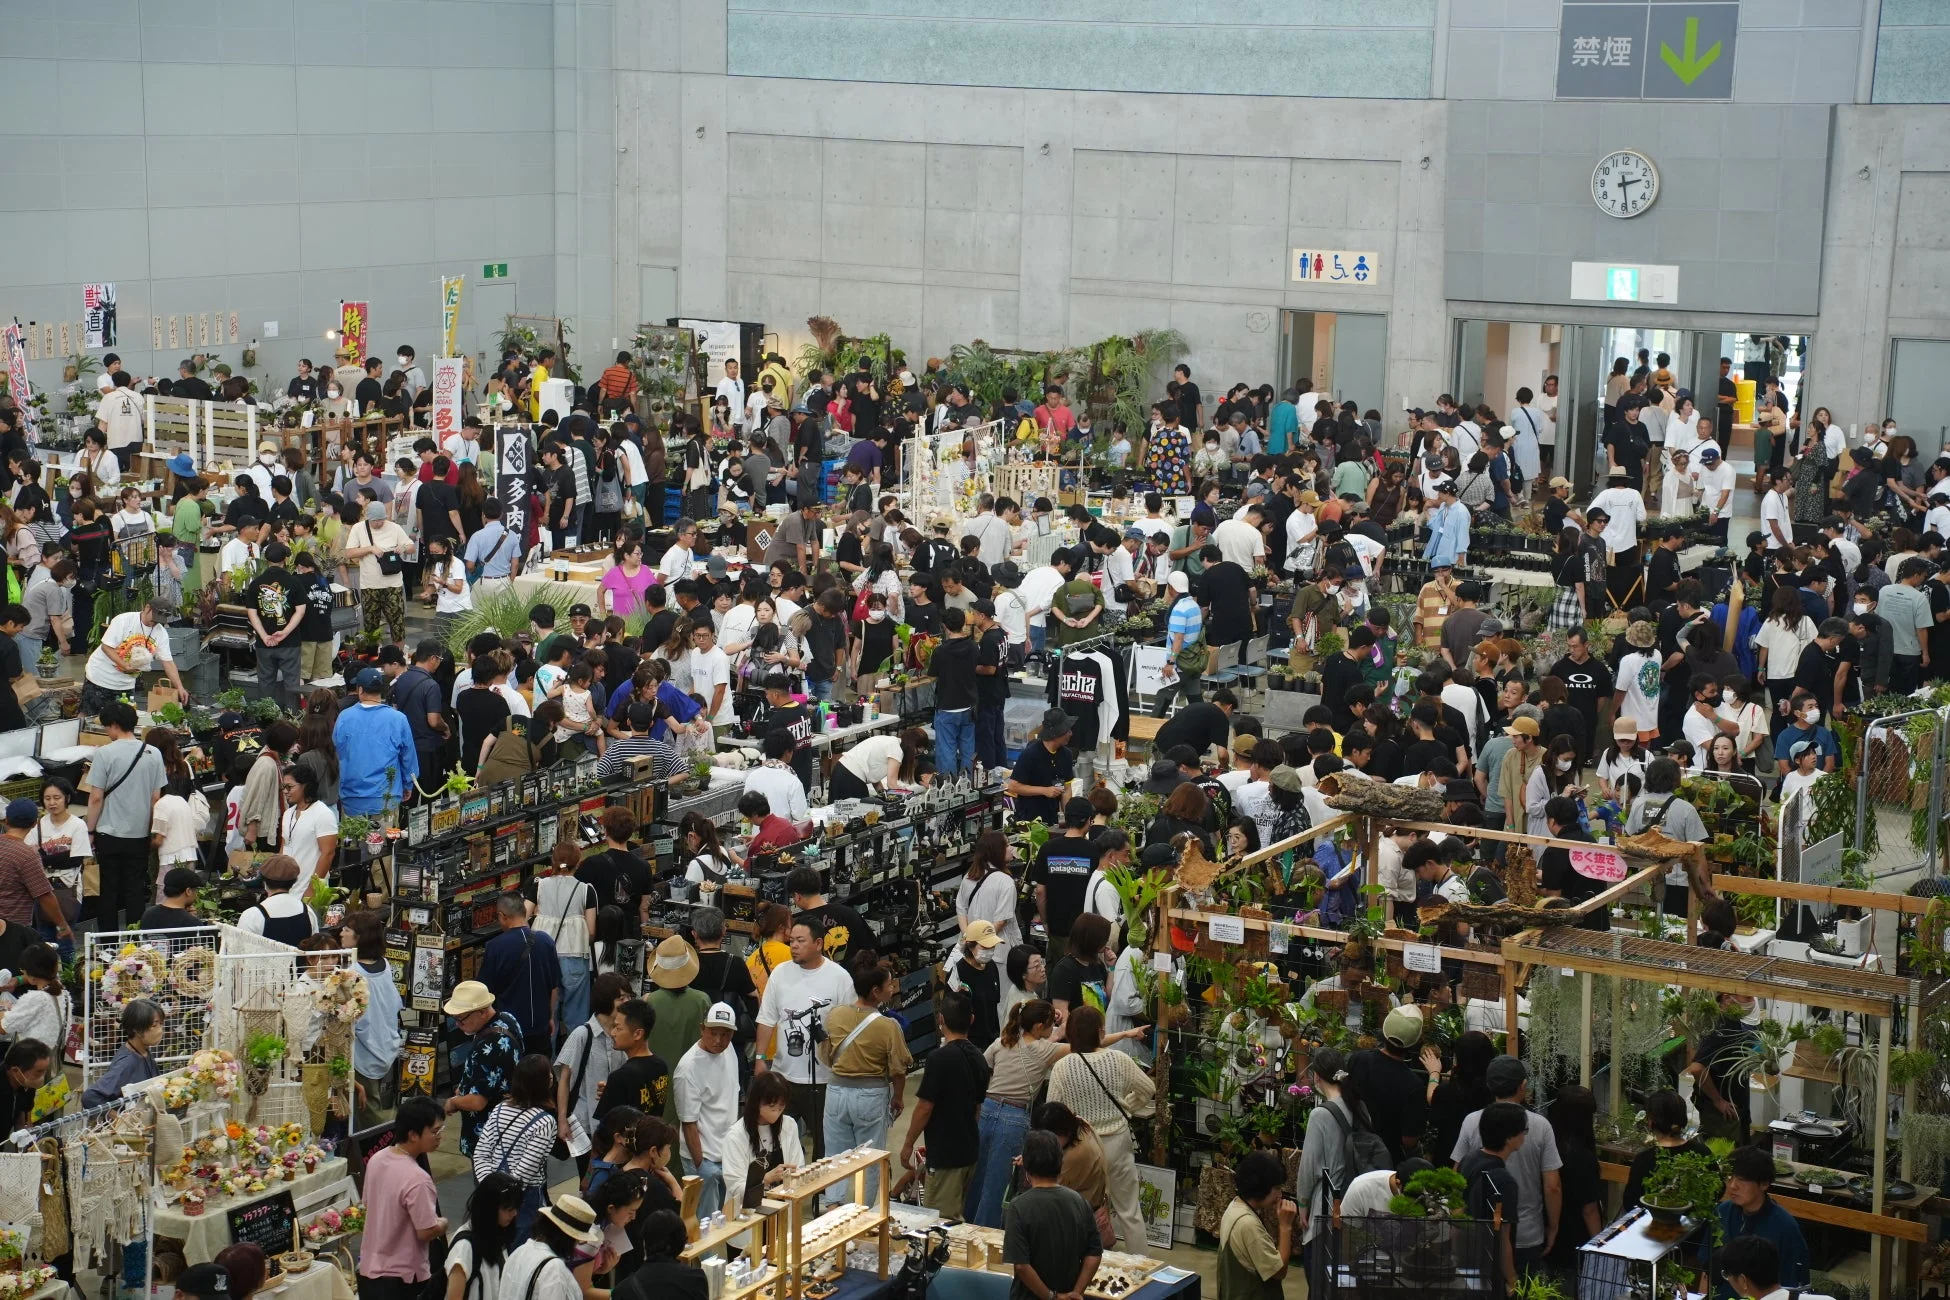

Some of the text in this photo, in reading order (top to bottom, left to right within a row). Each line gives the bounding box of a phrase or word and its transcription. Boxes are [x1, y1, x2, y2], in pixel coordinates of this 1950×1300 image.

[1572, 37, 1632, 66] 禁煙
[1612, 159, 1618, 168] 11
[1622, 157, 1630, 165] 12
[1635, 159, 1639, 168] 1
[1602, 167, 1610, 176] 10
[1642, 168, 1648, 177] 2
[1599, 179, 1606, 188] 9
[1644, 180, 1650, 189] 3
[1602, 191, 1608, 200] 8
[1640, 192, 1647, 200] 4
[1610, 200, 1617, 209] 7
[1620, 203, 1627, 212] 6
[1631, 201, 1637, 209] 5
[1572, 850, 1616, 866] あく抜き
[1584, 865, 1625, 879] ベラボン
[411, 1061, 426, 1074] 66
